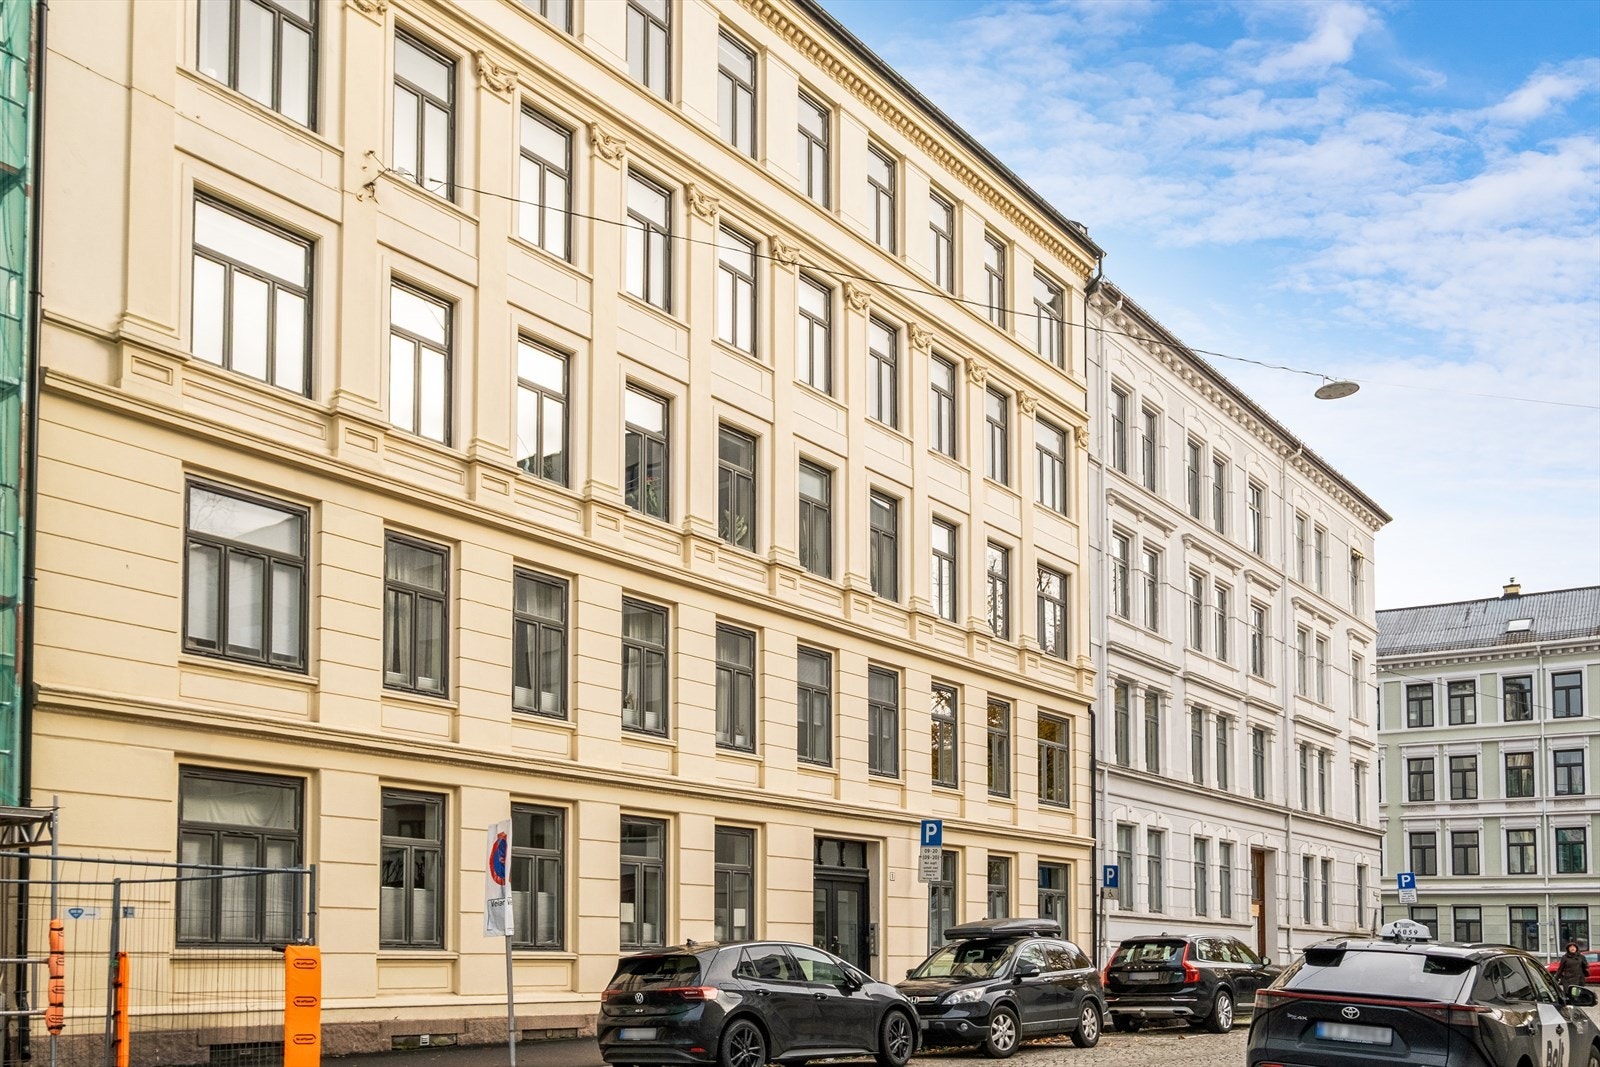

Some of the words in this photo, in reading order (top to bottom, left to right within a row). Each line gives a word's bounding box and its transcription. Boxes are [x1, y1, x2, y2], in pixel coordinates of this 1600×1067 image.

[926, 823, 938, 844] P
[1106, 867, 1115, 885] P
[1401, 875, 1411, 888] P
[1546, 1038, 1565, 1067] Bolt
